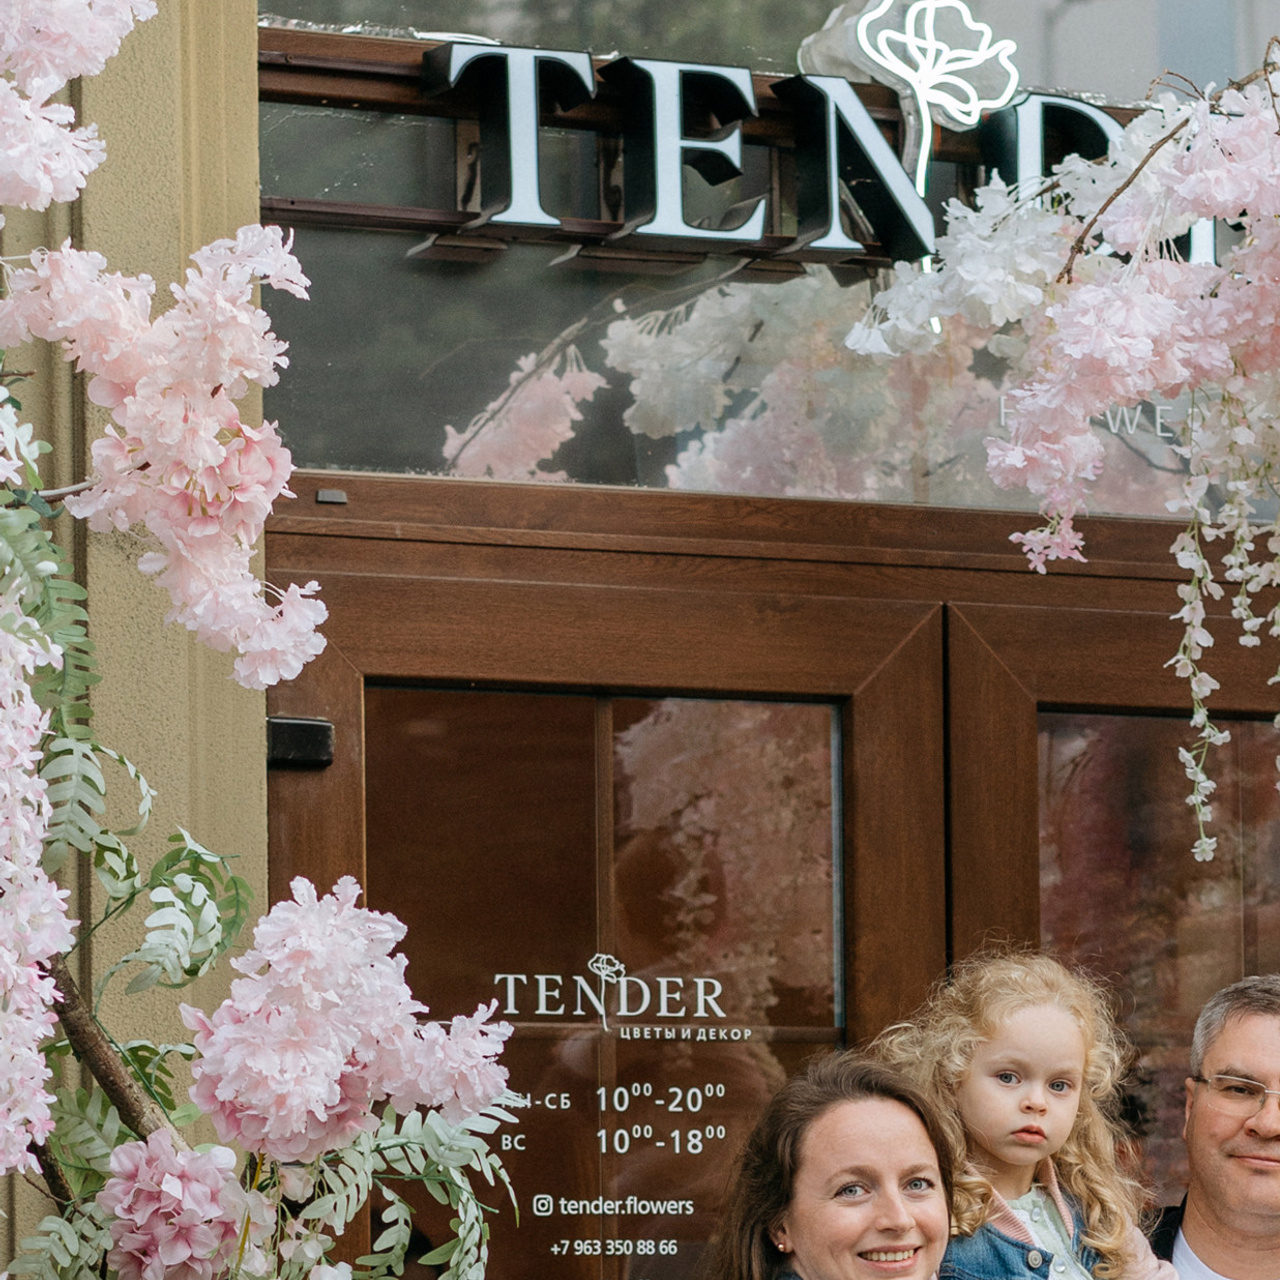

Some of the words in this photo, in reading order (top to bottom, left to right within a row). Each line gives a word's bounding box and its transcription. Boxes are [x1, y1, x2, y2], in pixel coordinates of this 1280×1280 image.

[494, 974, 727, 1018] TENDER
[620, 1027, 676, 1040] ЦВЕТЫ
[681, 1028, 692, 1040] И
[696, 1028, 752, 1042] ДЕКОР
[501, 1092, 571, 1110] Н-СБ
[501, 1134, 526, 1151] ВС
[558, 1195, 695, 1216] tender.flowers
[550, 1239, 570, 1256] +7
[573, 1239, 602, 1256] 963
[605, 1239, 634, 1256] 350
[636, 1239, 656, 1256] 88
[658, 1239, 678, 1256] 66
